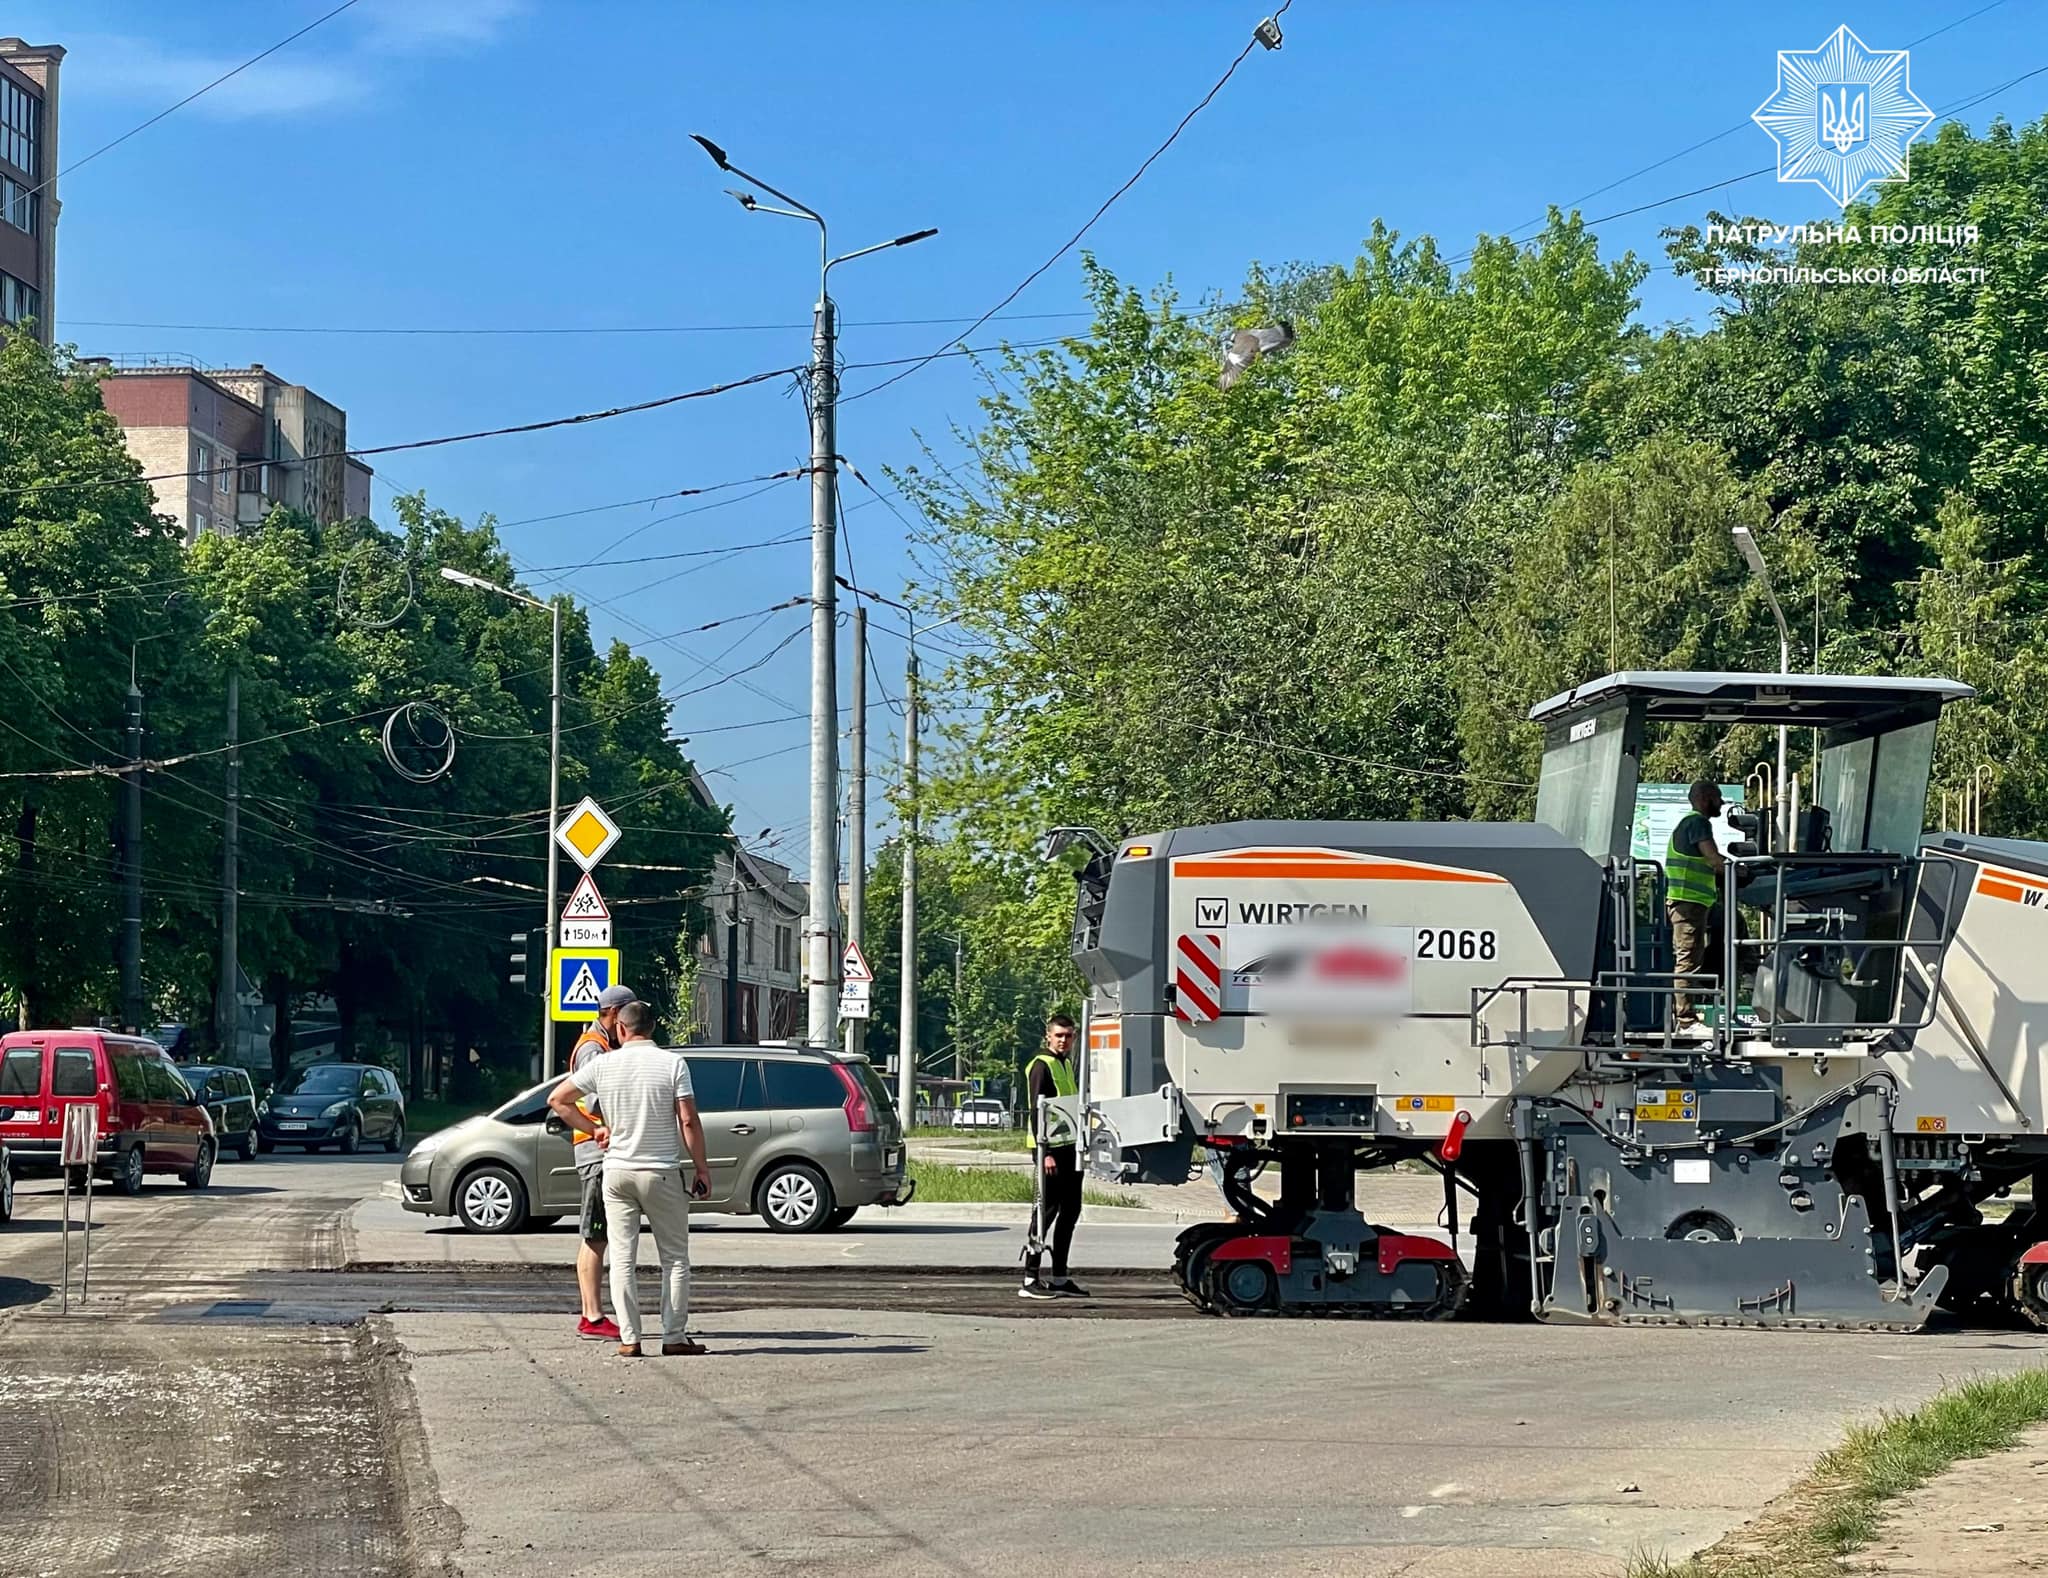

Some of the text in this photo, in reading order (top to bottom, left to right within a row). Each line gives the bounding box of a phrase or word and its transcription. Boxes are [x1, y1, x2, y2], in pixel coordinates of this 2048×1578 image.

[1239, 903, 1368, 924] WIRTGEN
[573, 928, 590, 940] 150
[1417, 929, 1496, 960] 2068
